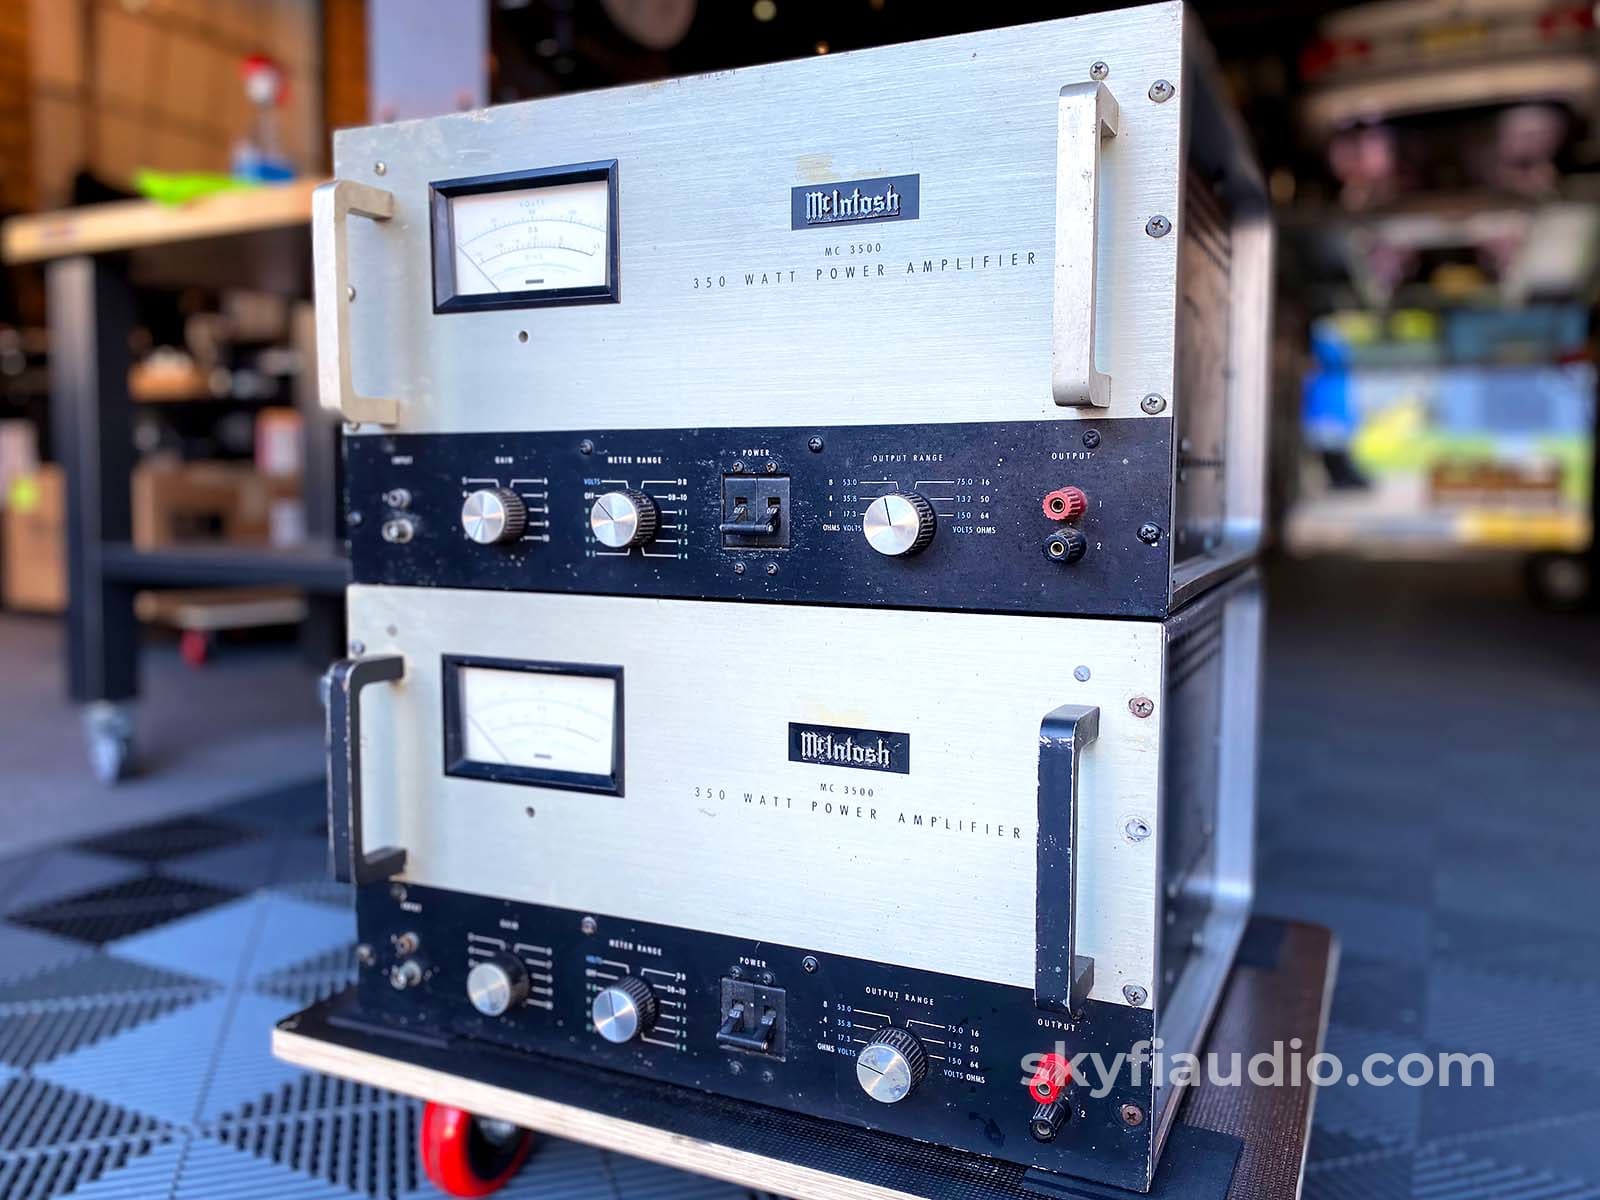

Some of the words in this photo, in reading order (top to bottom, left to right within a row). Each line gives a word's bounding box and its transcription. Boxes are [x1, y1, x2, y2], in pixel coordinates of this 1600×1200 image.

[805, 184, 901, 224] McIntosh
[824, 246, 841, 257] MC
[850, 242, 882, 255] 3500
[693, 276, 727, 290] 350
[745, 270, 796, 286] WATT
[816, 263, 886, 281] POWER
[906, 251, 1037, 275] AMPLIFIER
[742, 448, 770, 457] POWER
[872, 454, 907, 463] OUTPUT
[913, 453, 944, 462] RANGE
[1051, 451, 1092, 460] OUTPUT
[608, 456, 633, 465] METER
[636, 456, 662, 465] RANGE
[842, 478, 858, 487] 53.0
[956, 478, 974, 487] 75.0
[981, 479, 991, 487] 16
[842, 494, 858, 503] 35.8
[956, 495, 972, 504] 132
[980, 495, 991, 504] 50
[956, 512, 972, 520] 150
[980, 512, 990, 520] 64
[822, 523, 841, 532] OHMS
[843, 523, 863, 533] VOLTS
[952, 526, 973, 534] VOLTS
[976, 526, 997, 535] OHMS
[1096, 542, 1103, 550] 2
[800, 730, 891, 766] McIntosh
[819, 783, 835, 793] MC
[843, 785, 875, 797] 3500
[694, 786, 726, 801] 350
[744, 792, 792, 809] WATT
[811, 800, 877, 820] POWER
[898, 812, 1021, 840] AMPLIFIER
[637, 944, 662, 956] RANGE
[739, 956, 767, 968] POWER
[865, 986, 899, 1000] OUTPUT
[905, 993, 934, 1006] RANGE
[822, 1016, 828, 1024] 4
[1037, 1018, 1076, 1032] OUTPUT
[947, 1024, 964, 1034] 75.0
[971, 1029, 980, 1038] 16
[837, 1033, 851, 1043] 17.3
[817, 1042, 835, 1053] OHMS
[837, 1046, 856, 1057] VOLTS
[948, 1040, 962, 1050] 132
[969, 1044, 979, 1053] 50
[948, 1056, 962, 1066] 150
[969, 1060, 979, 1069] 64
[943, 1069, 964, 1080] VOLTS
[966, 1073, 986, 1084] OHMS
[1080, 1110, 1086, 1118] 2
